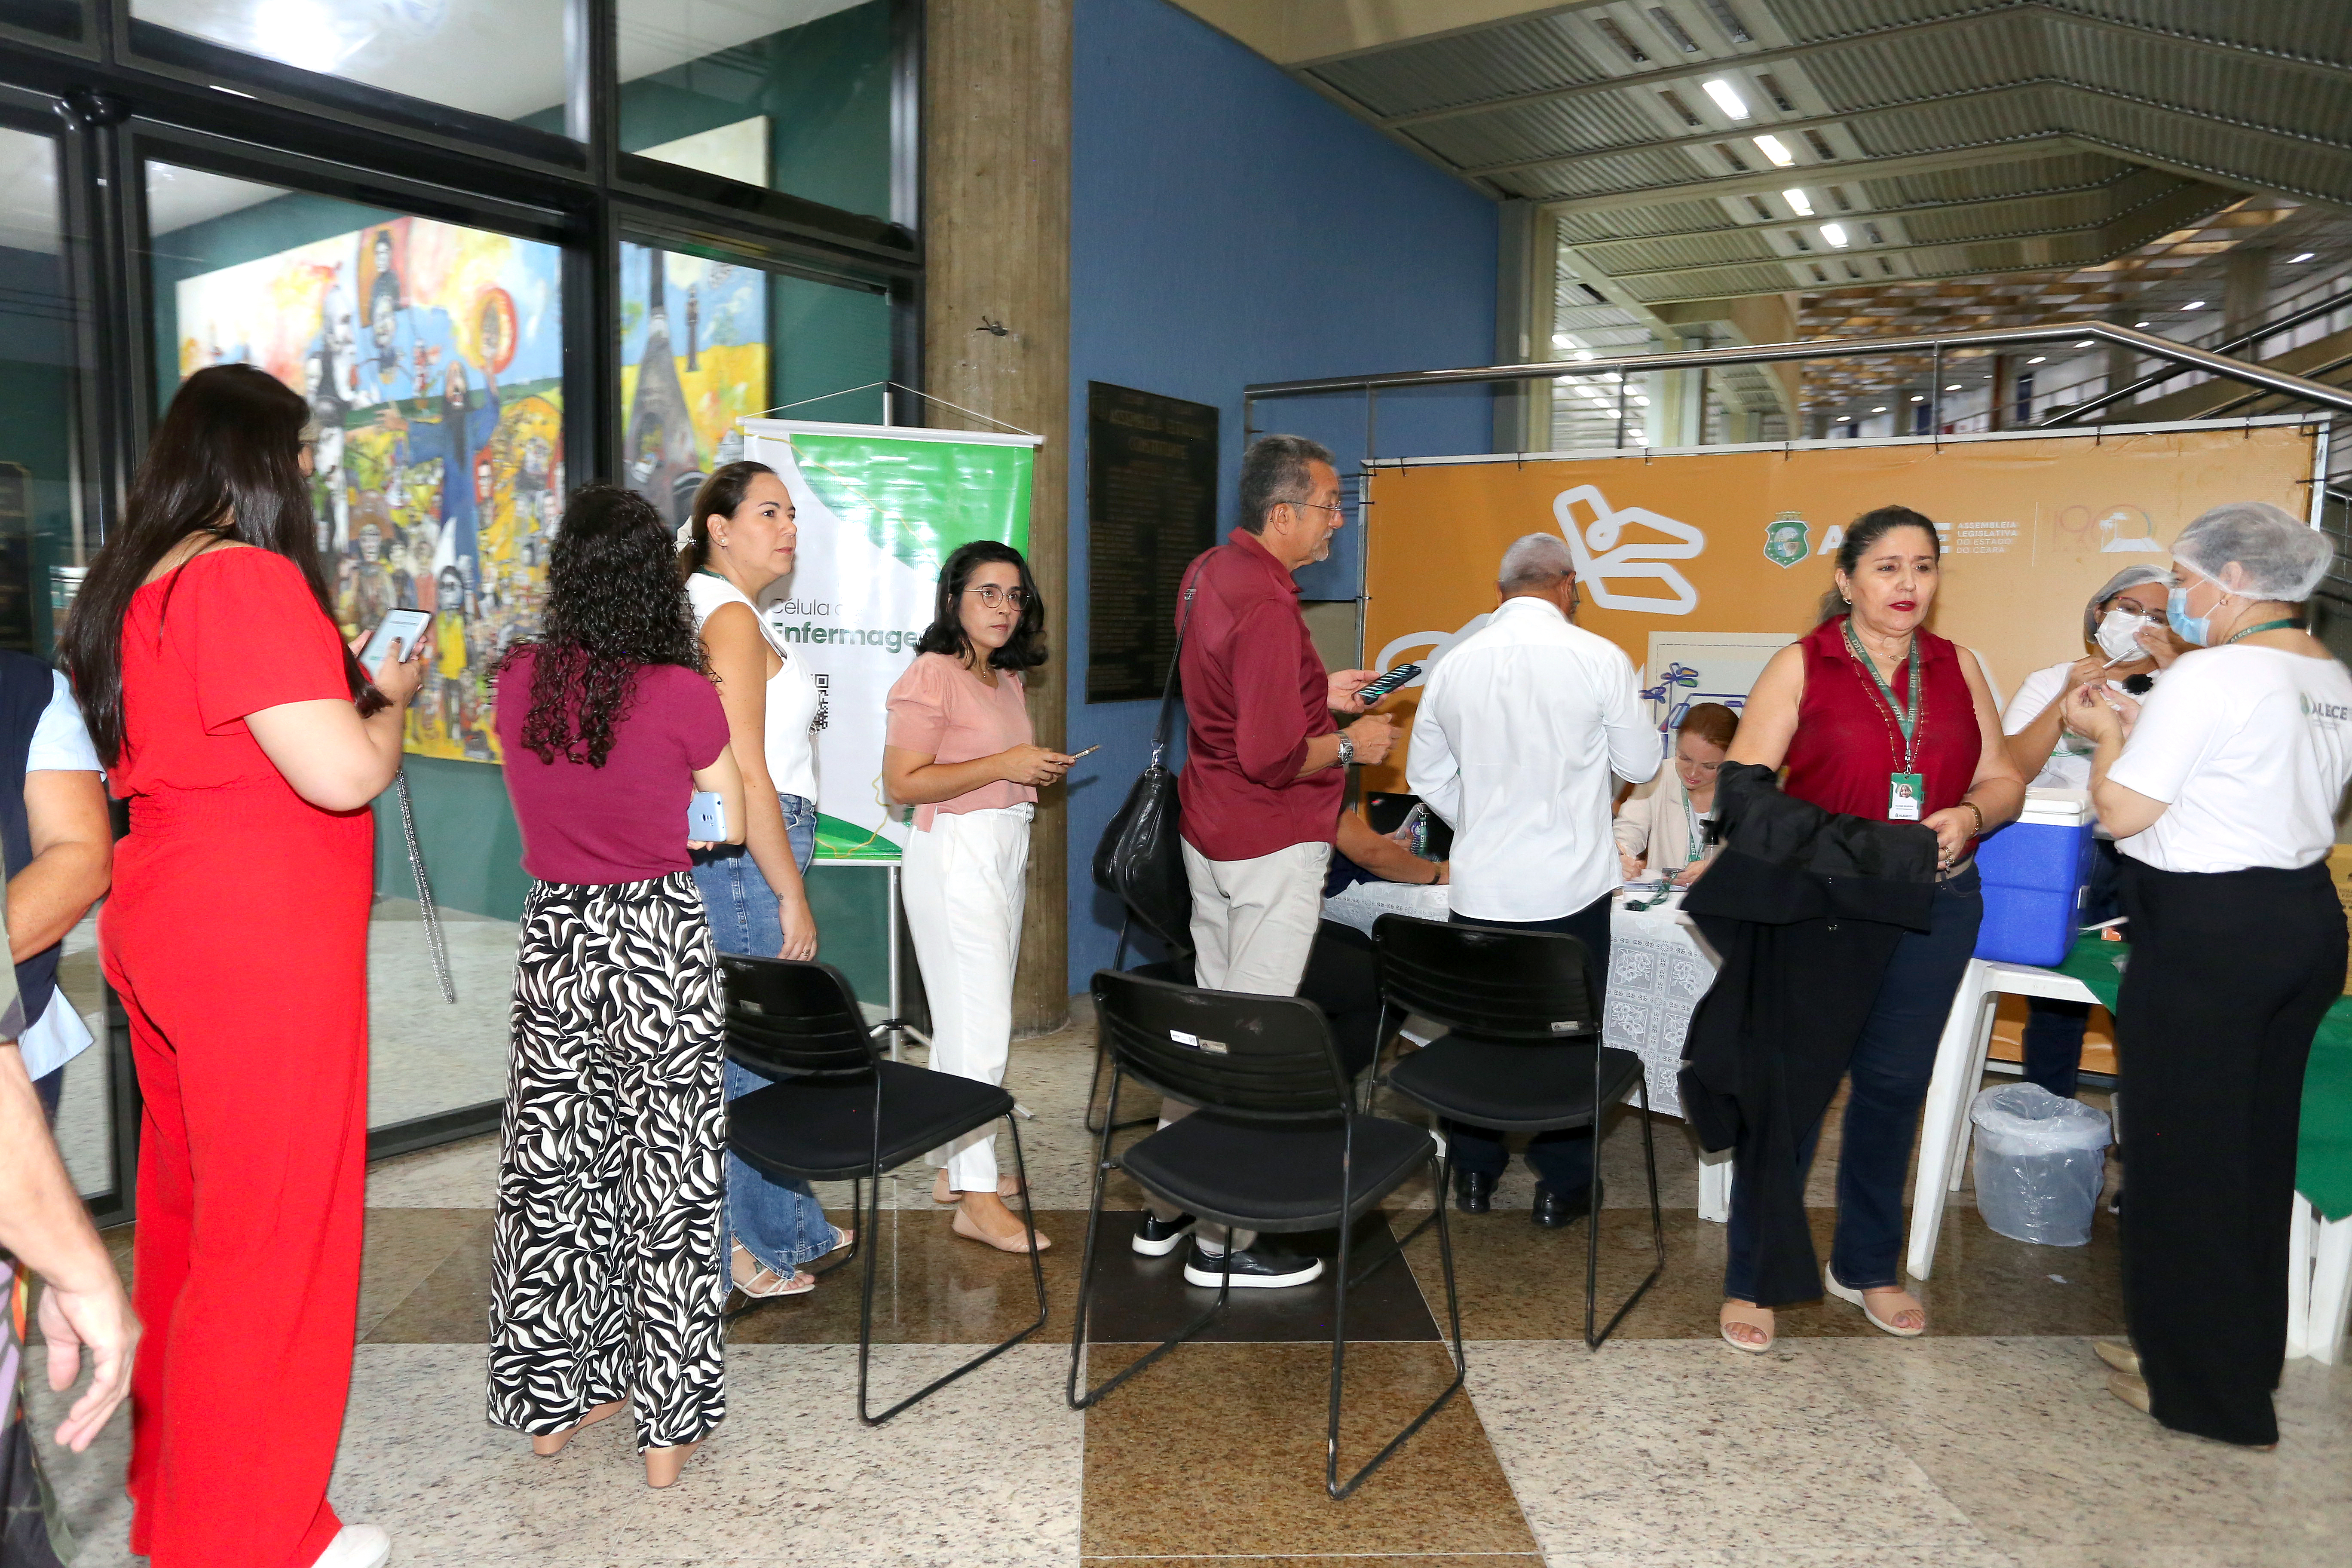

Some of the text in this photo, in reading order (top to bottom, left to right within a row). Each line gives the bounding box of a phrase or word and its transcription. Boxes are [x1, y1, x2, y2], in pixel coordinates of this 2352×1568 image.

[769, 598, 829, 615] Célula
[771, 622, 919, 653] Enfermage
[1852, 638, 1864, 653] ALECE
[1871, 671, 1886, 686] ALECE
[1892, 704, 1905, 721] ALECE
[2312, 702, 2348, 720] ALECE
